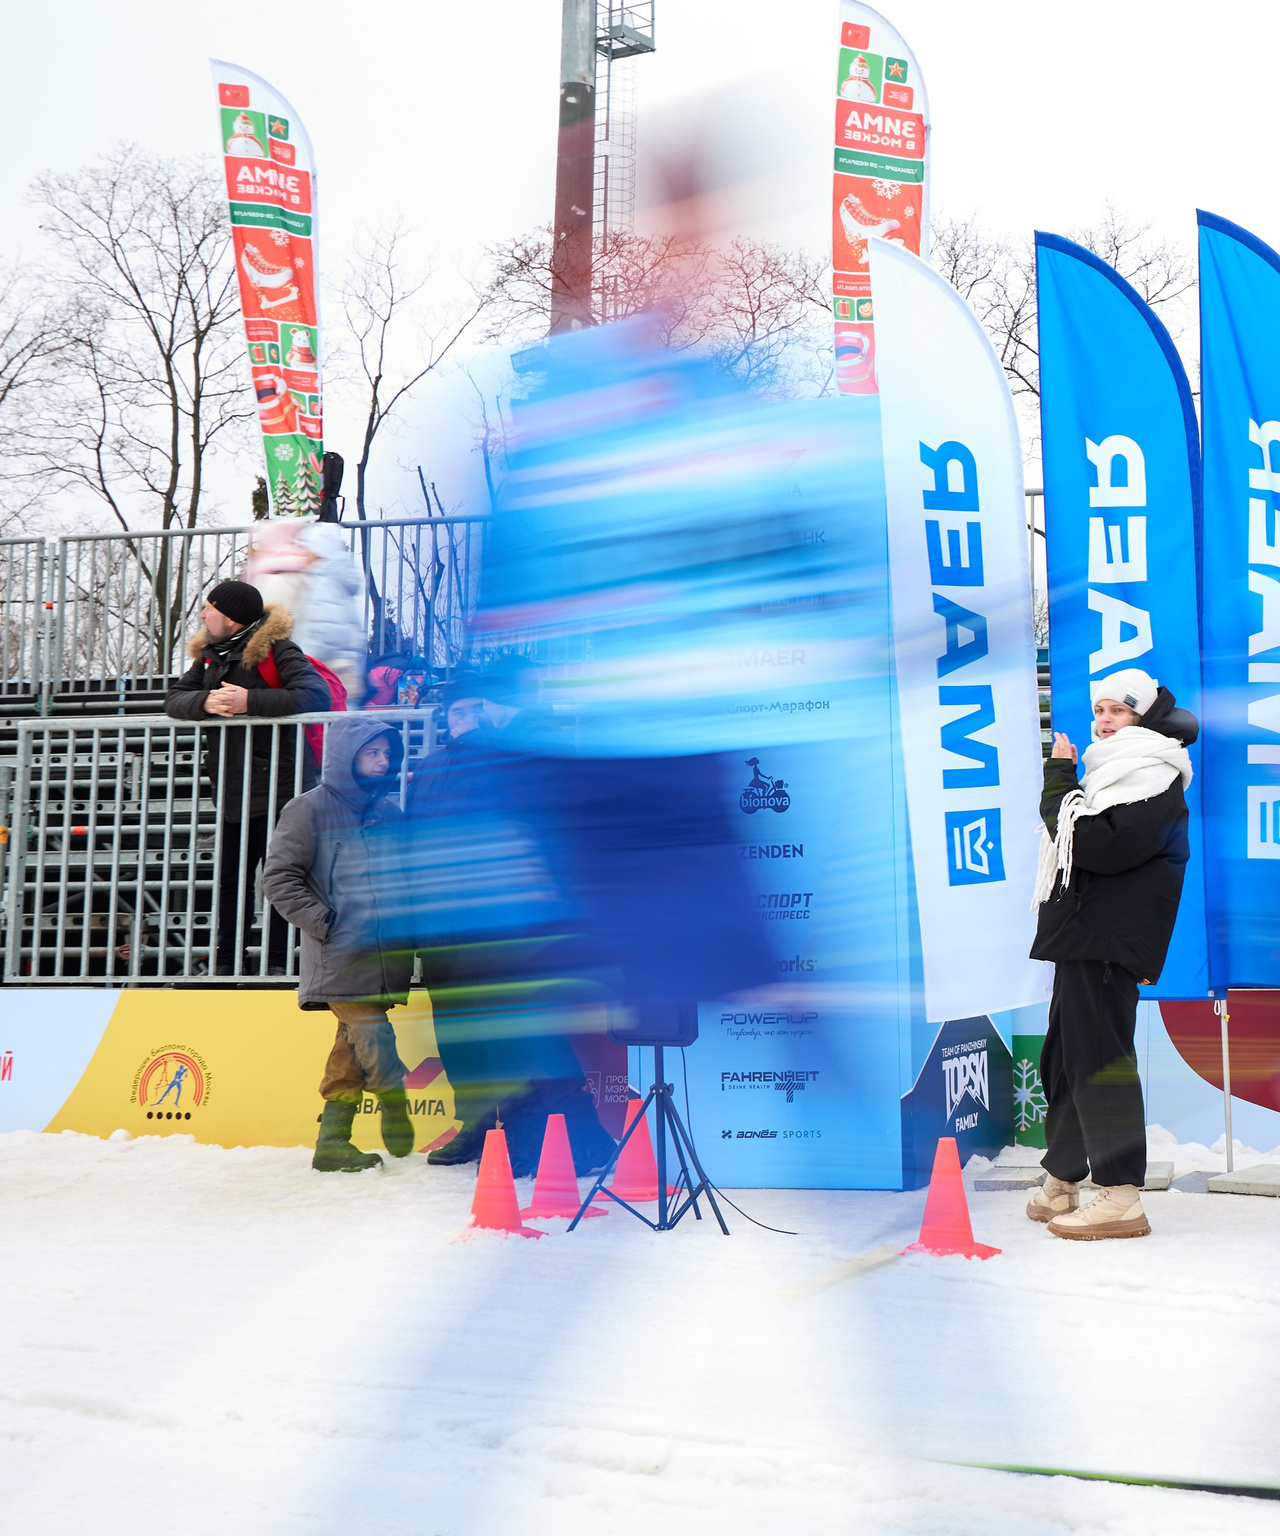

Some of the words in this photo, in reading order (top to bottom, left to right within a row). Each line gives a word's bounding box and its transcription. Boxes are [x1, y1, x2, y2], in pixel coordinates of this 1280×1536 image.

[738, 843, 804, 859] ZENDEN
[757, 893, 814, 909] СПОРТ
[720, 1011, 819, 1025] POWERUP
[941, 1047, 955, 1058] TEAM
[954, 1045, 961, 1055] OF
[960, 1038, 988, 1054] PANZHINSKIY
[130, 1056, 151, 1104] Федерация
[150, 1044, 186, 1057] биатлона
[187, 1047, 208, 1071] города
[202, 1072, 213, 1106] Москвы
[605, 1075, 628, 1084] ПРОЕ
[721, 1070, 820, 1083] FAHRENHEIT
[941, 1050, 990, 1128] TOPSKI
[604, 1095, 628, 1103] МОСК
[955, 1111, 979, 1133] FAMILY
[782, 1130, 822, 1139] SPORTS
